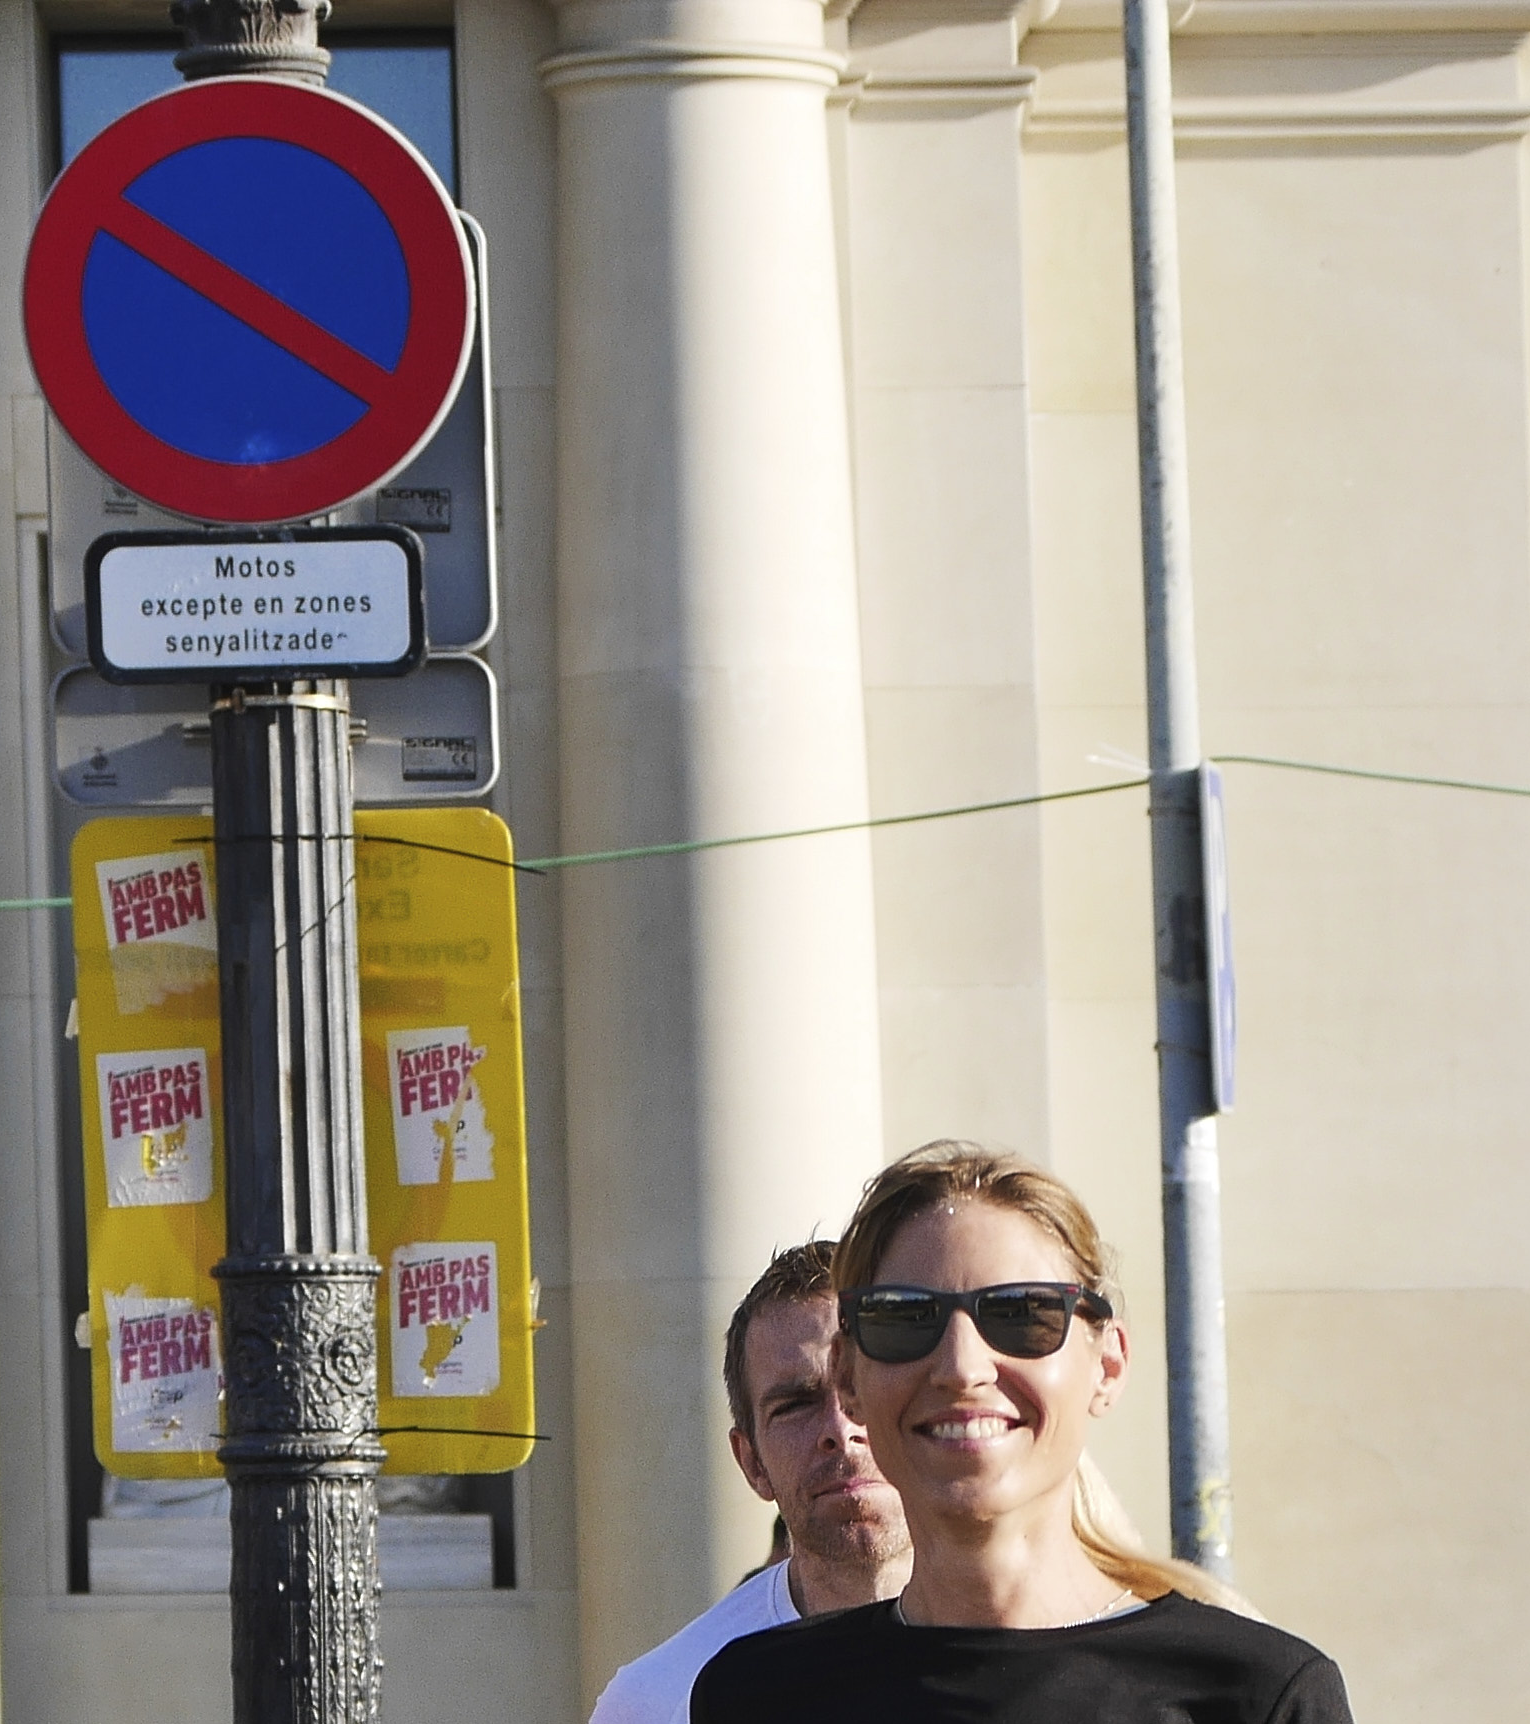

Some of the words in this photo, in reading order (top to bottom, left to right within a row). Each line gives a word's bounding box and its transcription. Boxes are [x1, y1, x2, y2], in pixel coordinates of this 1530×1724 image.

[214, 556, 296, 579] Motos
[141, 595, 243, 620] excepte
[254, 595, 284, 615] en
[294, 593, 371, 614] zones
[165, 628, 349, 656] senyalitzade
[158, 861, 201, 893] PAS
[114, 883, 206, 943] FERM
[158, 1060, 201, 1090] PAS
[400, 1067, 472, 1117] FER
[110, 1083, 202, 1139] FERM
[448, 1254, 490, 1283] PAS
[399, 1277, 489, 1329] FERM
[169, 1310, 212, 1339] PAS
[121, 1333, 210, 1385] FERM
